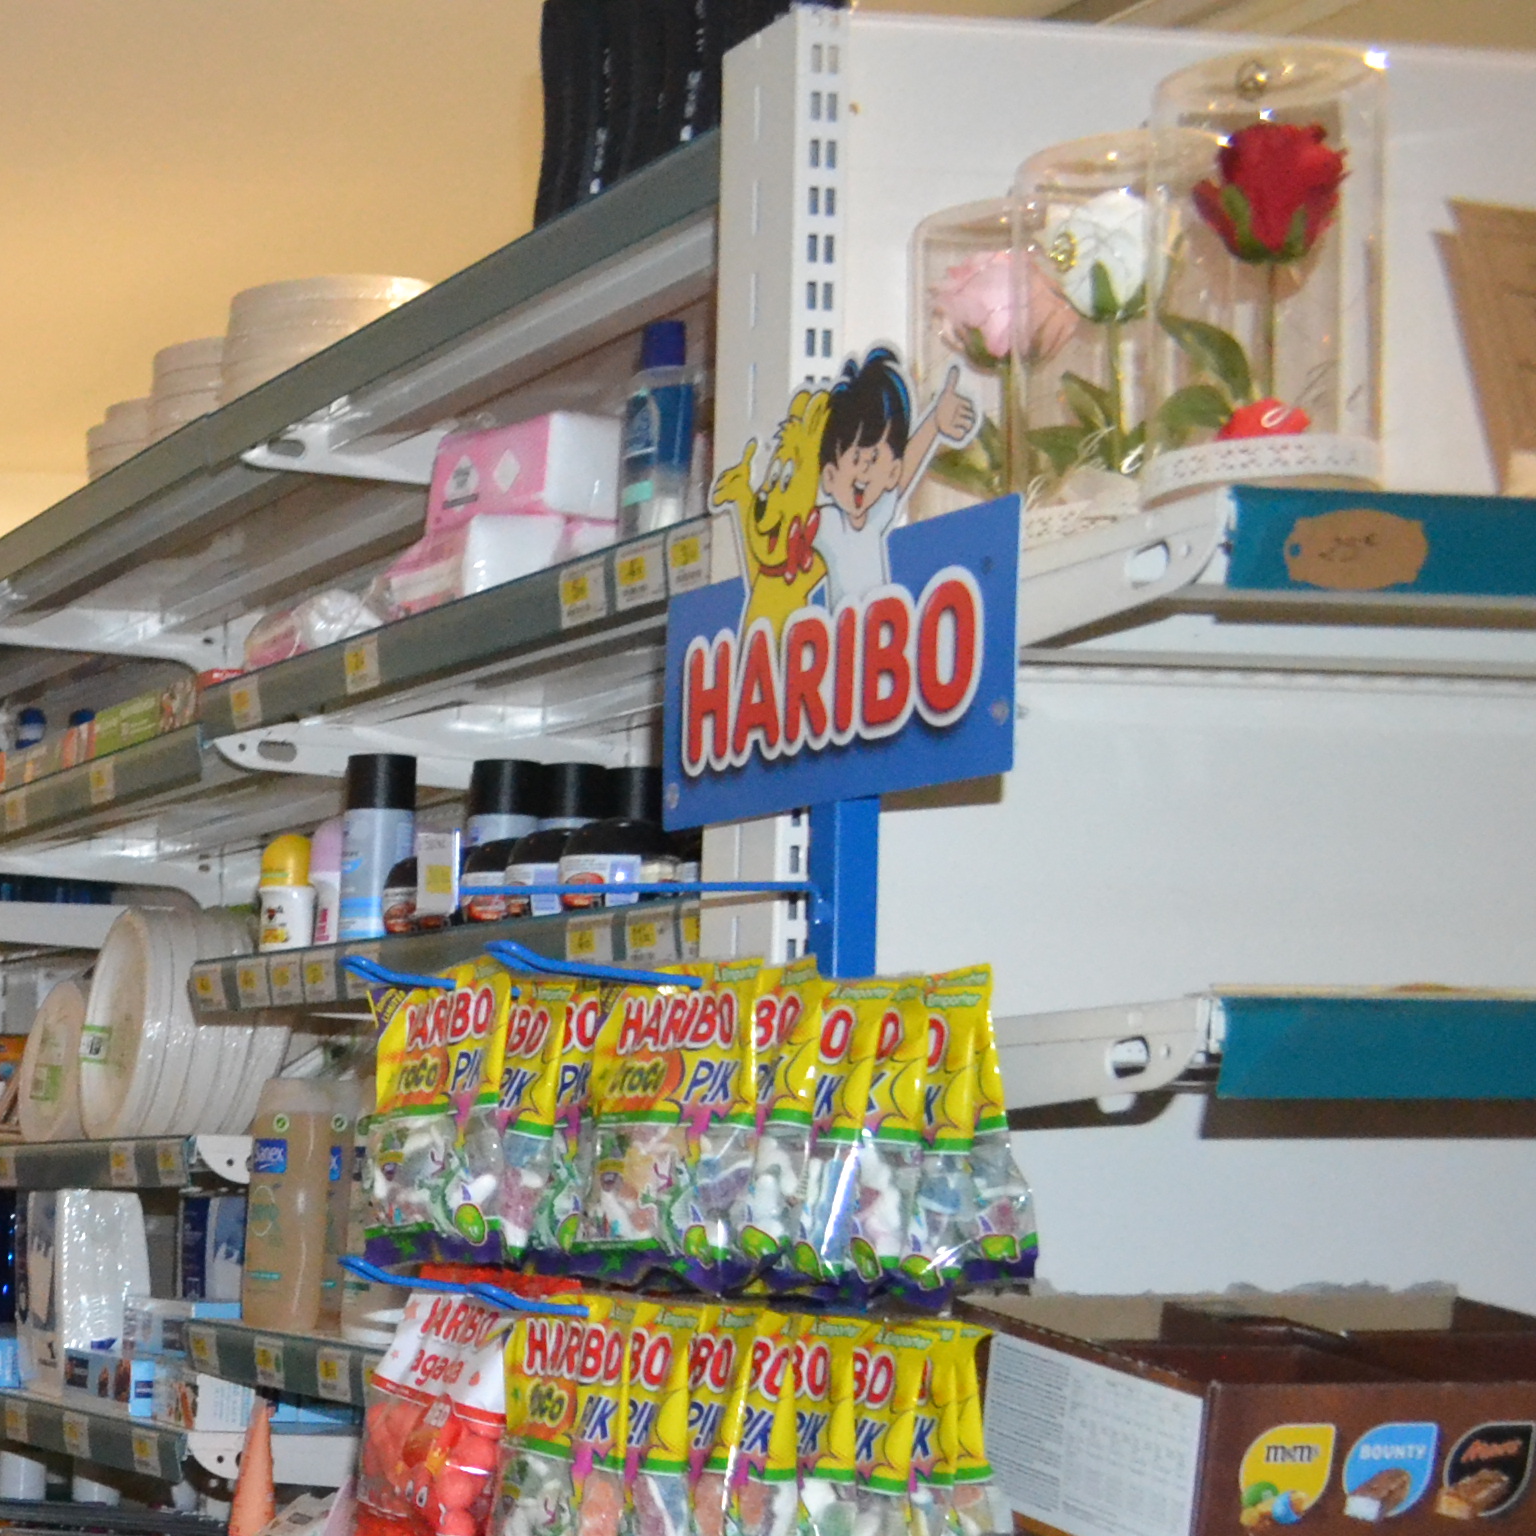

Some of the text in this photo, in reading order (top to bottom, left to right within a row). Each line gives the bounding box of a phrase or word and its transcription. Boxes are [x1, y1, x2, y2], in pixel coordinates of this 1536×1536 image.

[684, 570, 981, 774] HARIBO
[618, 989, 738, 1055] HARIBO
[1359, 1444, 1427, 1461] BOUNTY
